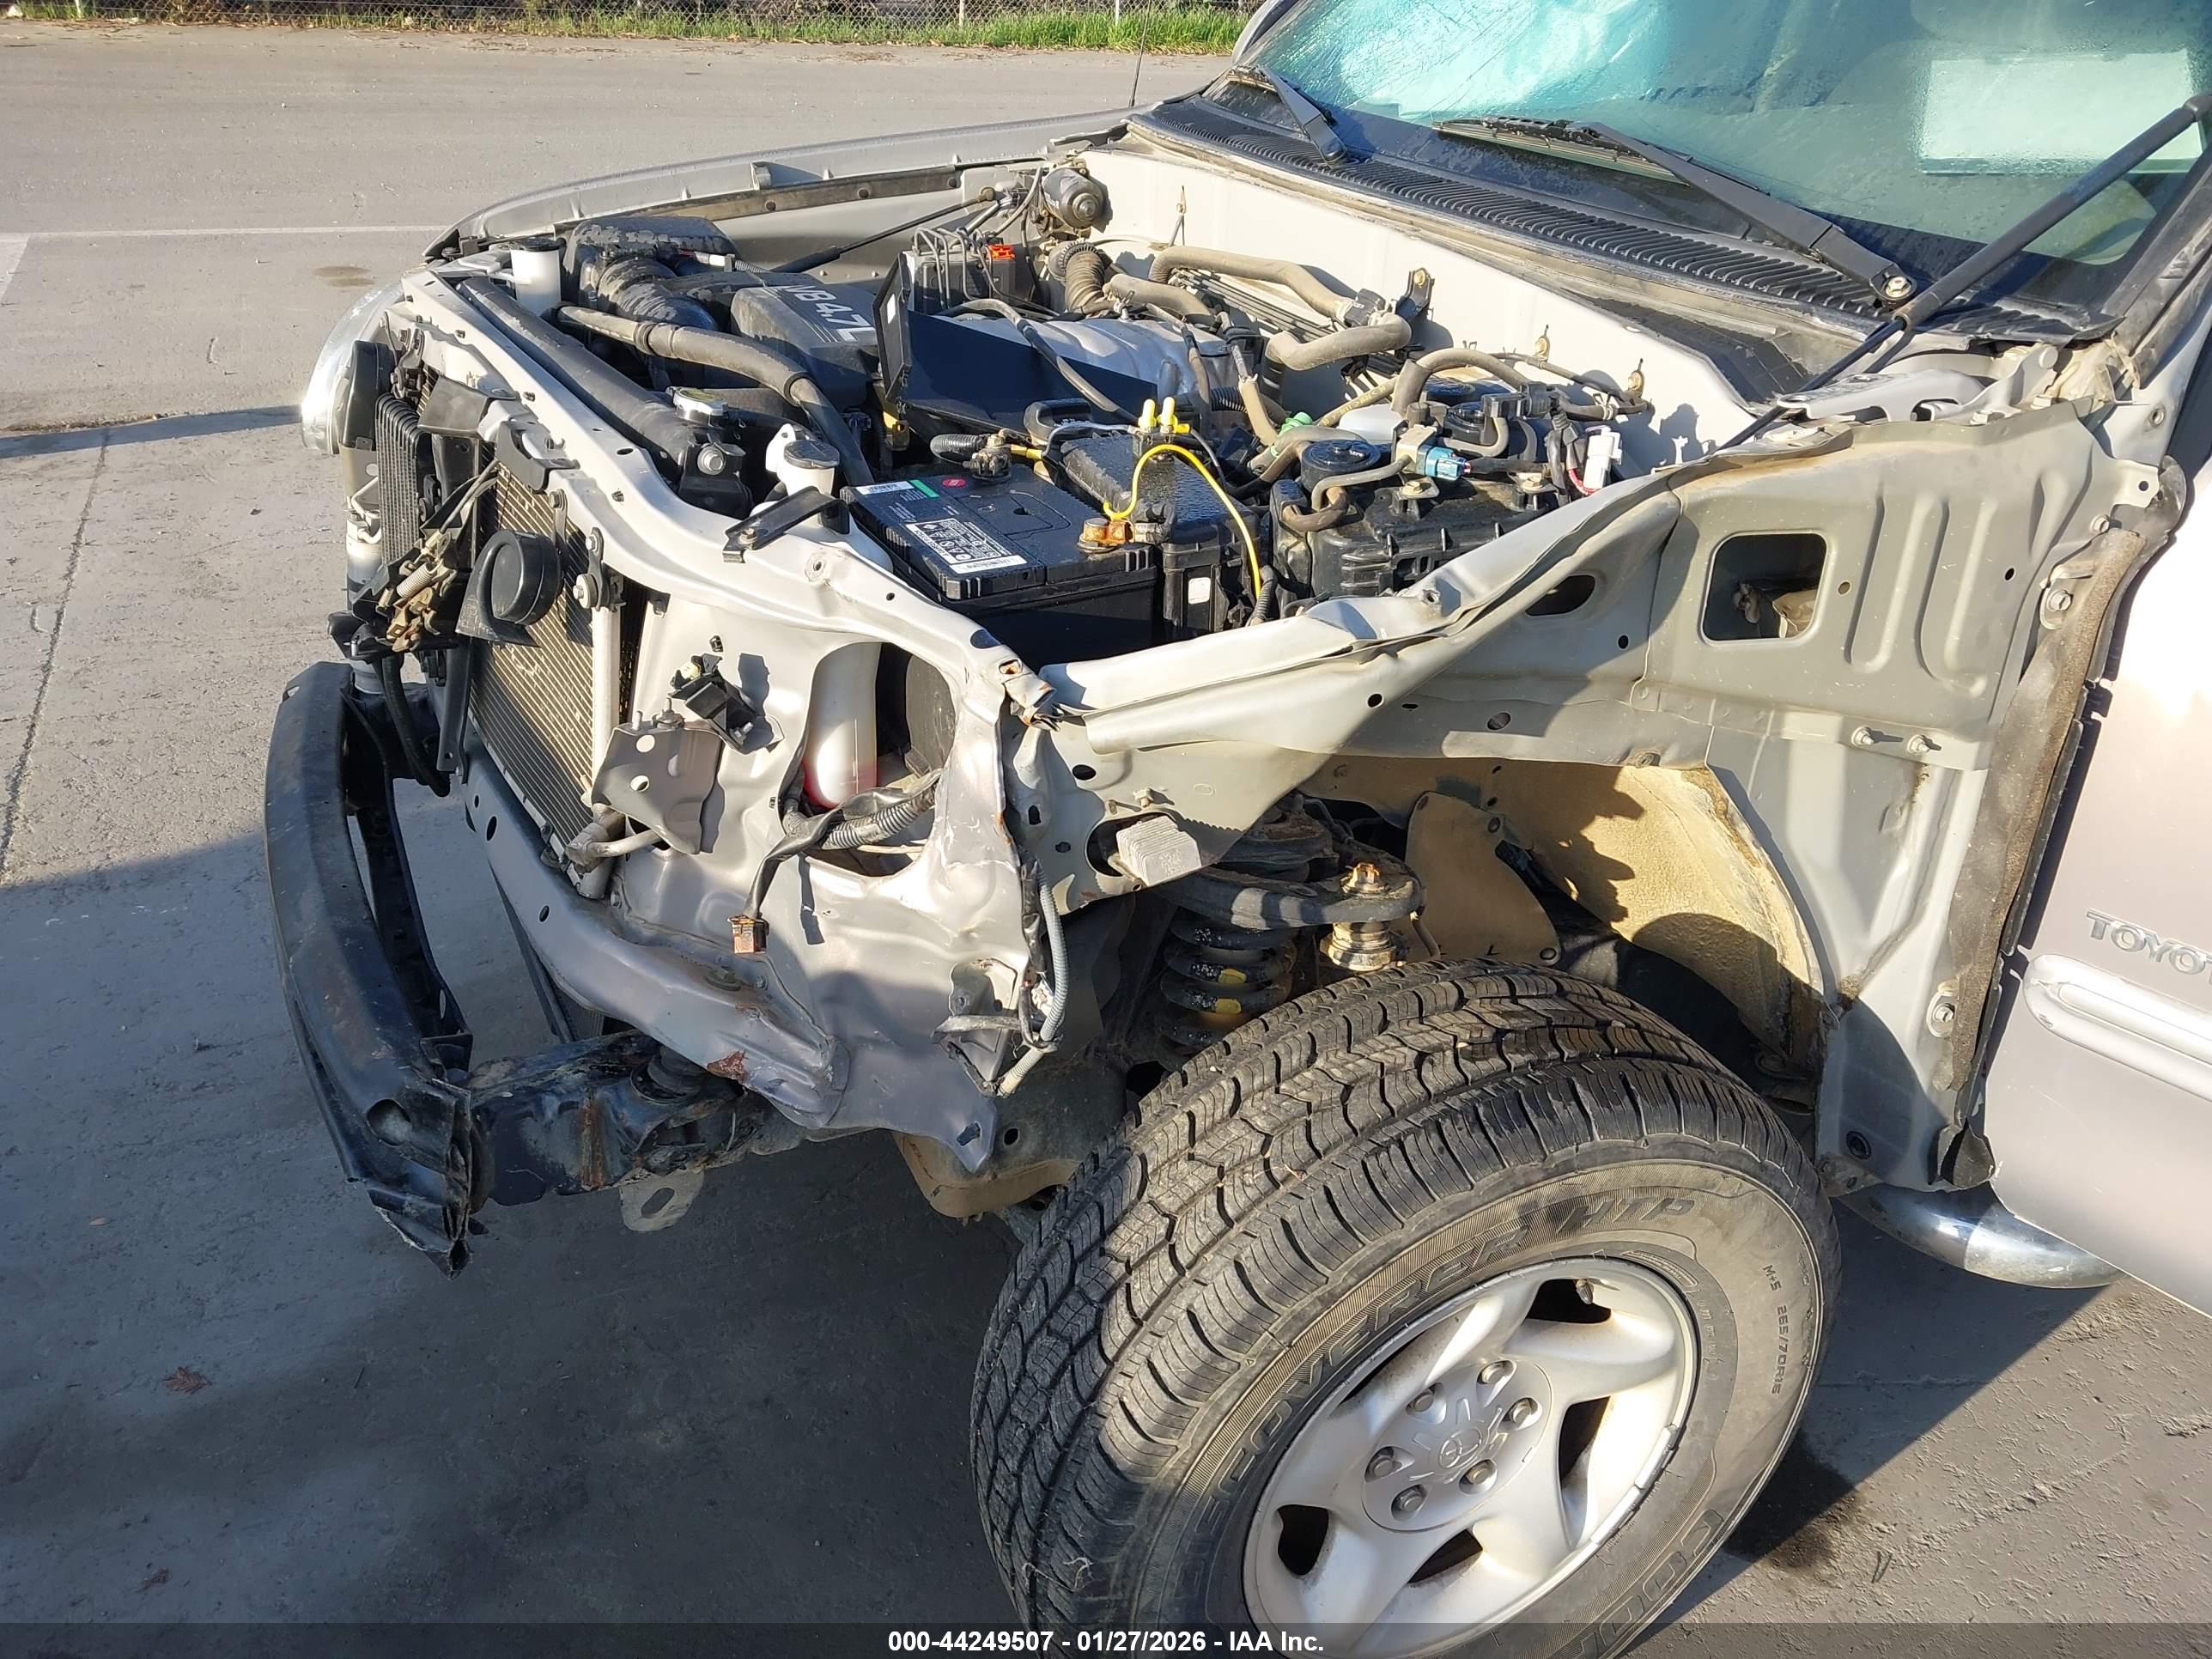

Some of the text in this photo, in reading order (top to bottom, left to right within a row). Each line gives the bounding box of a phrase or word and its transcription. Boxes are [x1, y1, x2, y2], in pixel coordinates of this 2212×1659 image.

[783, 285, 876, 342] V8 4.7L
[2087, 908, 2212, 986] TOYO
[1557, 1197, 1695, 1234] HTP
[1762, 1263, 1790, 1395] M+S 265/70R16
